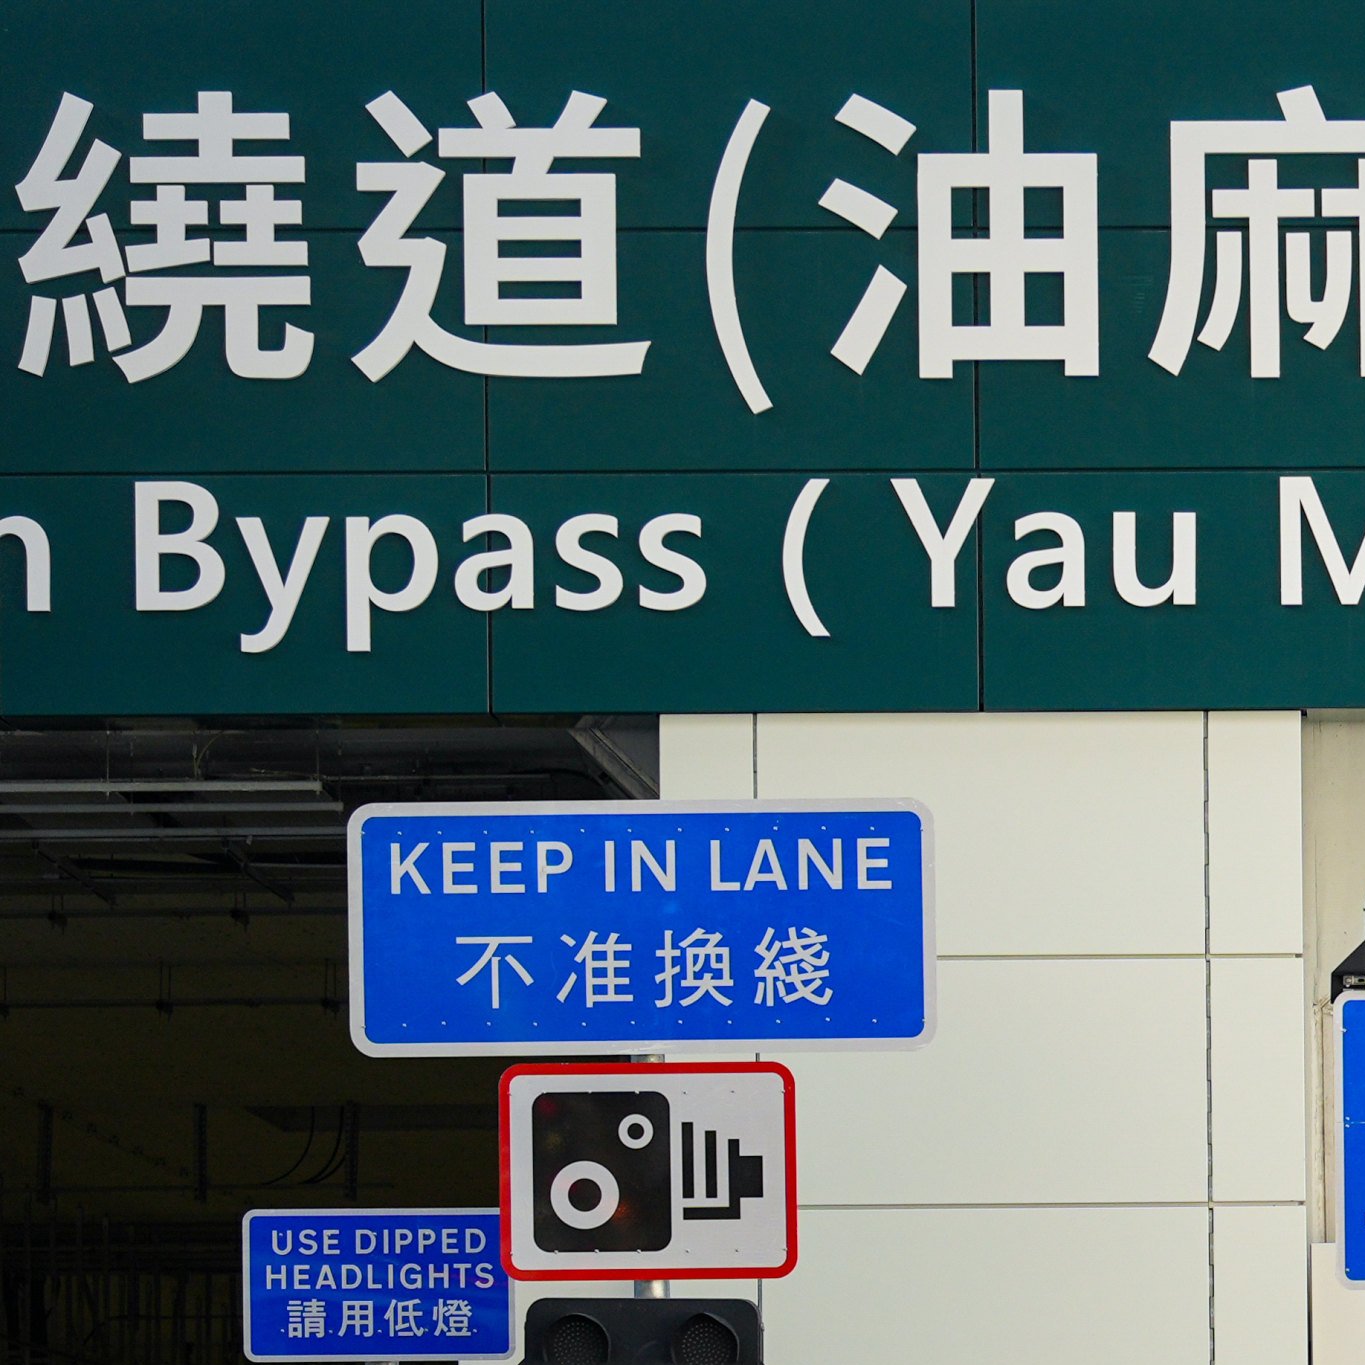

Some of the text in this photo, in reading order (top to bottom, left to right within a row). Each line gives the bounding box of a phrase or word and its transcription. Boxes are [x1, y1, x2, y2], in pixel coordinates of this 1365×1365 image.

[134, 479, 708, 653] Bypass
[890, 476, 1197, 607] Yau
[390, 837, 893, 895] KEEP IN LANE
[454, 927, 834, 1009] 不准換綫
[271, 1226, 487, 1255] USE DIPPED
[265, 1261, 495, 1290] HEADLIGHTS
[286, 1298, 474, 1339] 請用低燈
